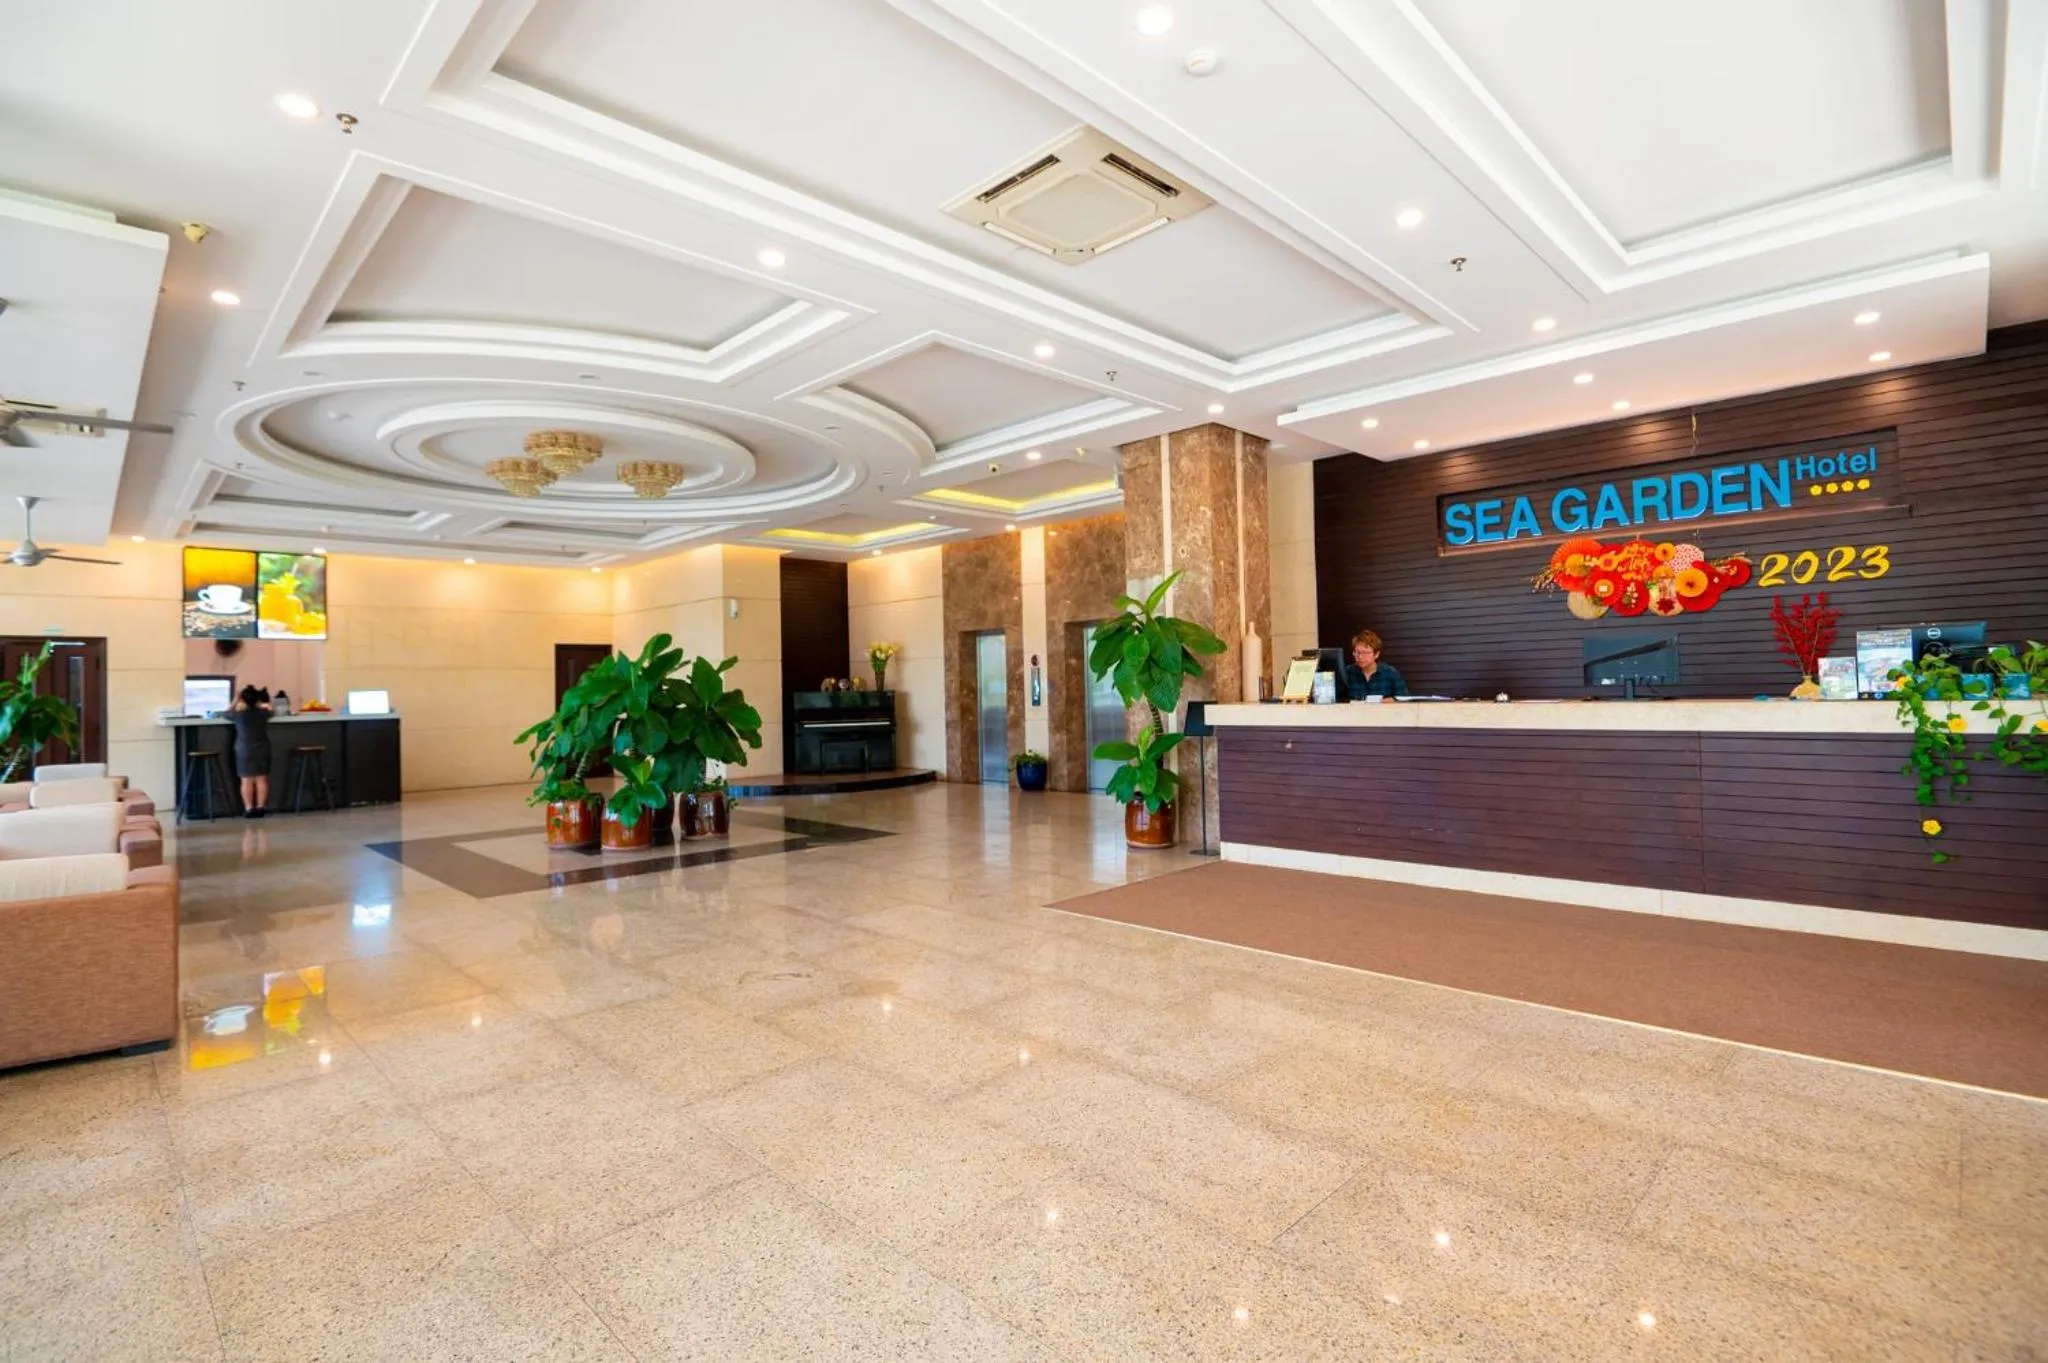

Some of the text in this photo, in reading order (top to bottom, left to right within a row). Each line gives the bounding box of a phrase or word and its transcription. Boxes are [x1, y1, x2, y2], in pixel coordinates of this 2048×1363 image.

[1446, 448, 1877, 545] SEA GARDEN Hotel
[1758, 545, 1891, 588] 2023
